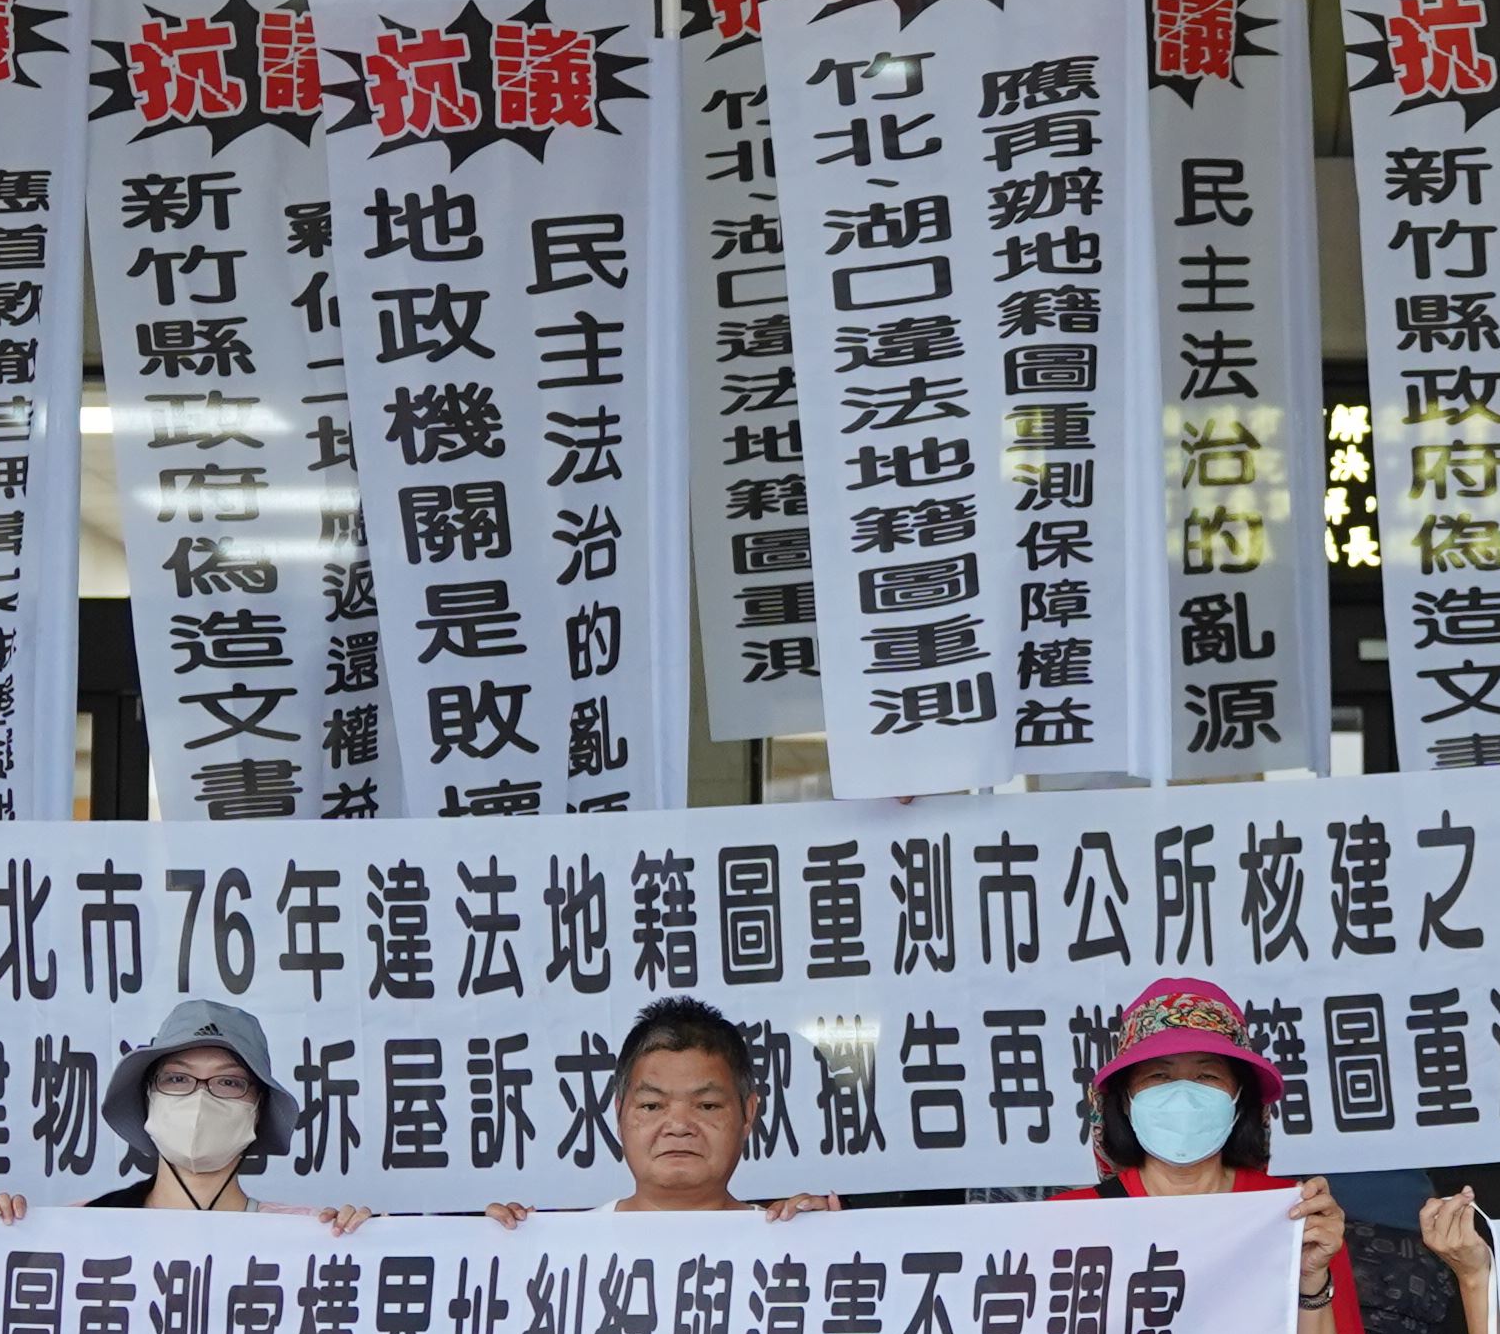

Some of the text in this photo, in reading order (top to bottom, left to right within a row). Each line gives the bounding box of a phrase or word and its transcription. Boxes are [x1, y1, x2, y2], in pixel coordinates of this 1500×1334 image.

[128, 8, 323, 123] 抗議
[365, 22, 601, 137] 抗議
[122, 170, 303, 819] 新竹縣政府偽造文書
[978, 56, 1103, 748] 應再辦地籍圖重測保障權益
[1174, 157, 1281, 754] 民主法治的亂源
